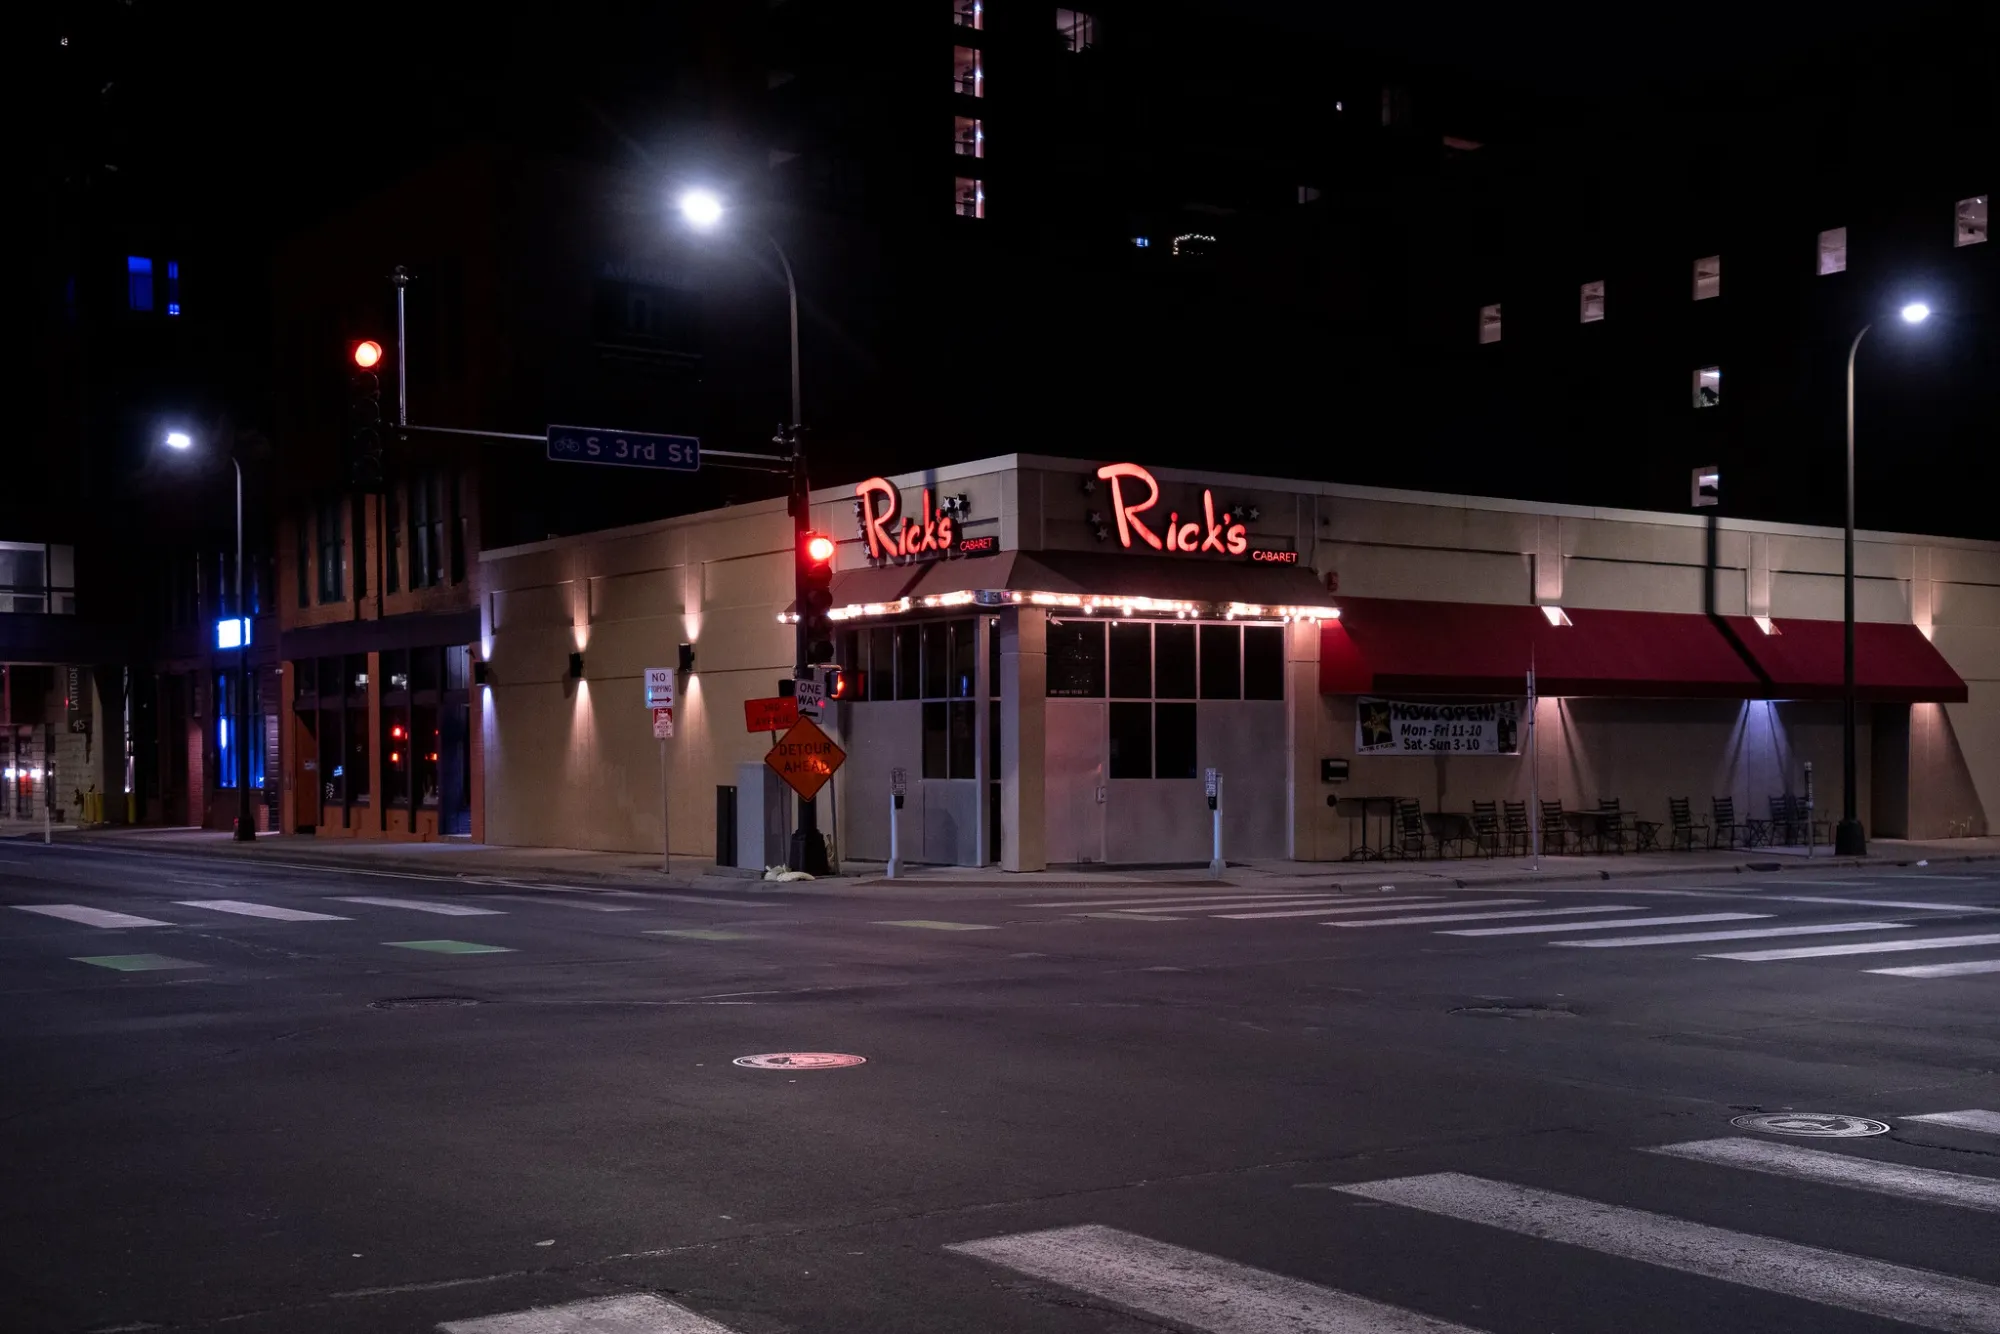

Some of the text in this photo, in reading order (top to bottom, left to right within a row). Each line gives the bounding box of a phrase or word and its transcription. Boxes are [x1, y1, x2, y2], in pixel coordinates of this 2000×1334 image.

[586, 436, 694, 464] S 3rd St
[1097, 462, 1248, 555] Rick's
[855, 475, 954, 559] Rick's
[959, 537, 993, 552] CABARET
[1252, 550, 1297, 563] CABARET
[652, 672, 666, 682] NO
[69, 667, 79, 711] LATITUDE
[799, 682, 822, 695] ONE
[798, 695, 821, 706] WAY
[72, 719, 86, 732] 45
[1452, 724, 1482, 737] 11-10
[779, 742, 832, 756] DETOUR
[1454, 738, 1480, 751] 3-10
[783, 759, 830, 774] AHEAD
